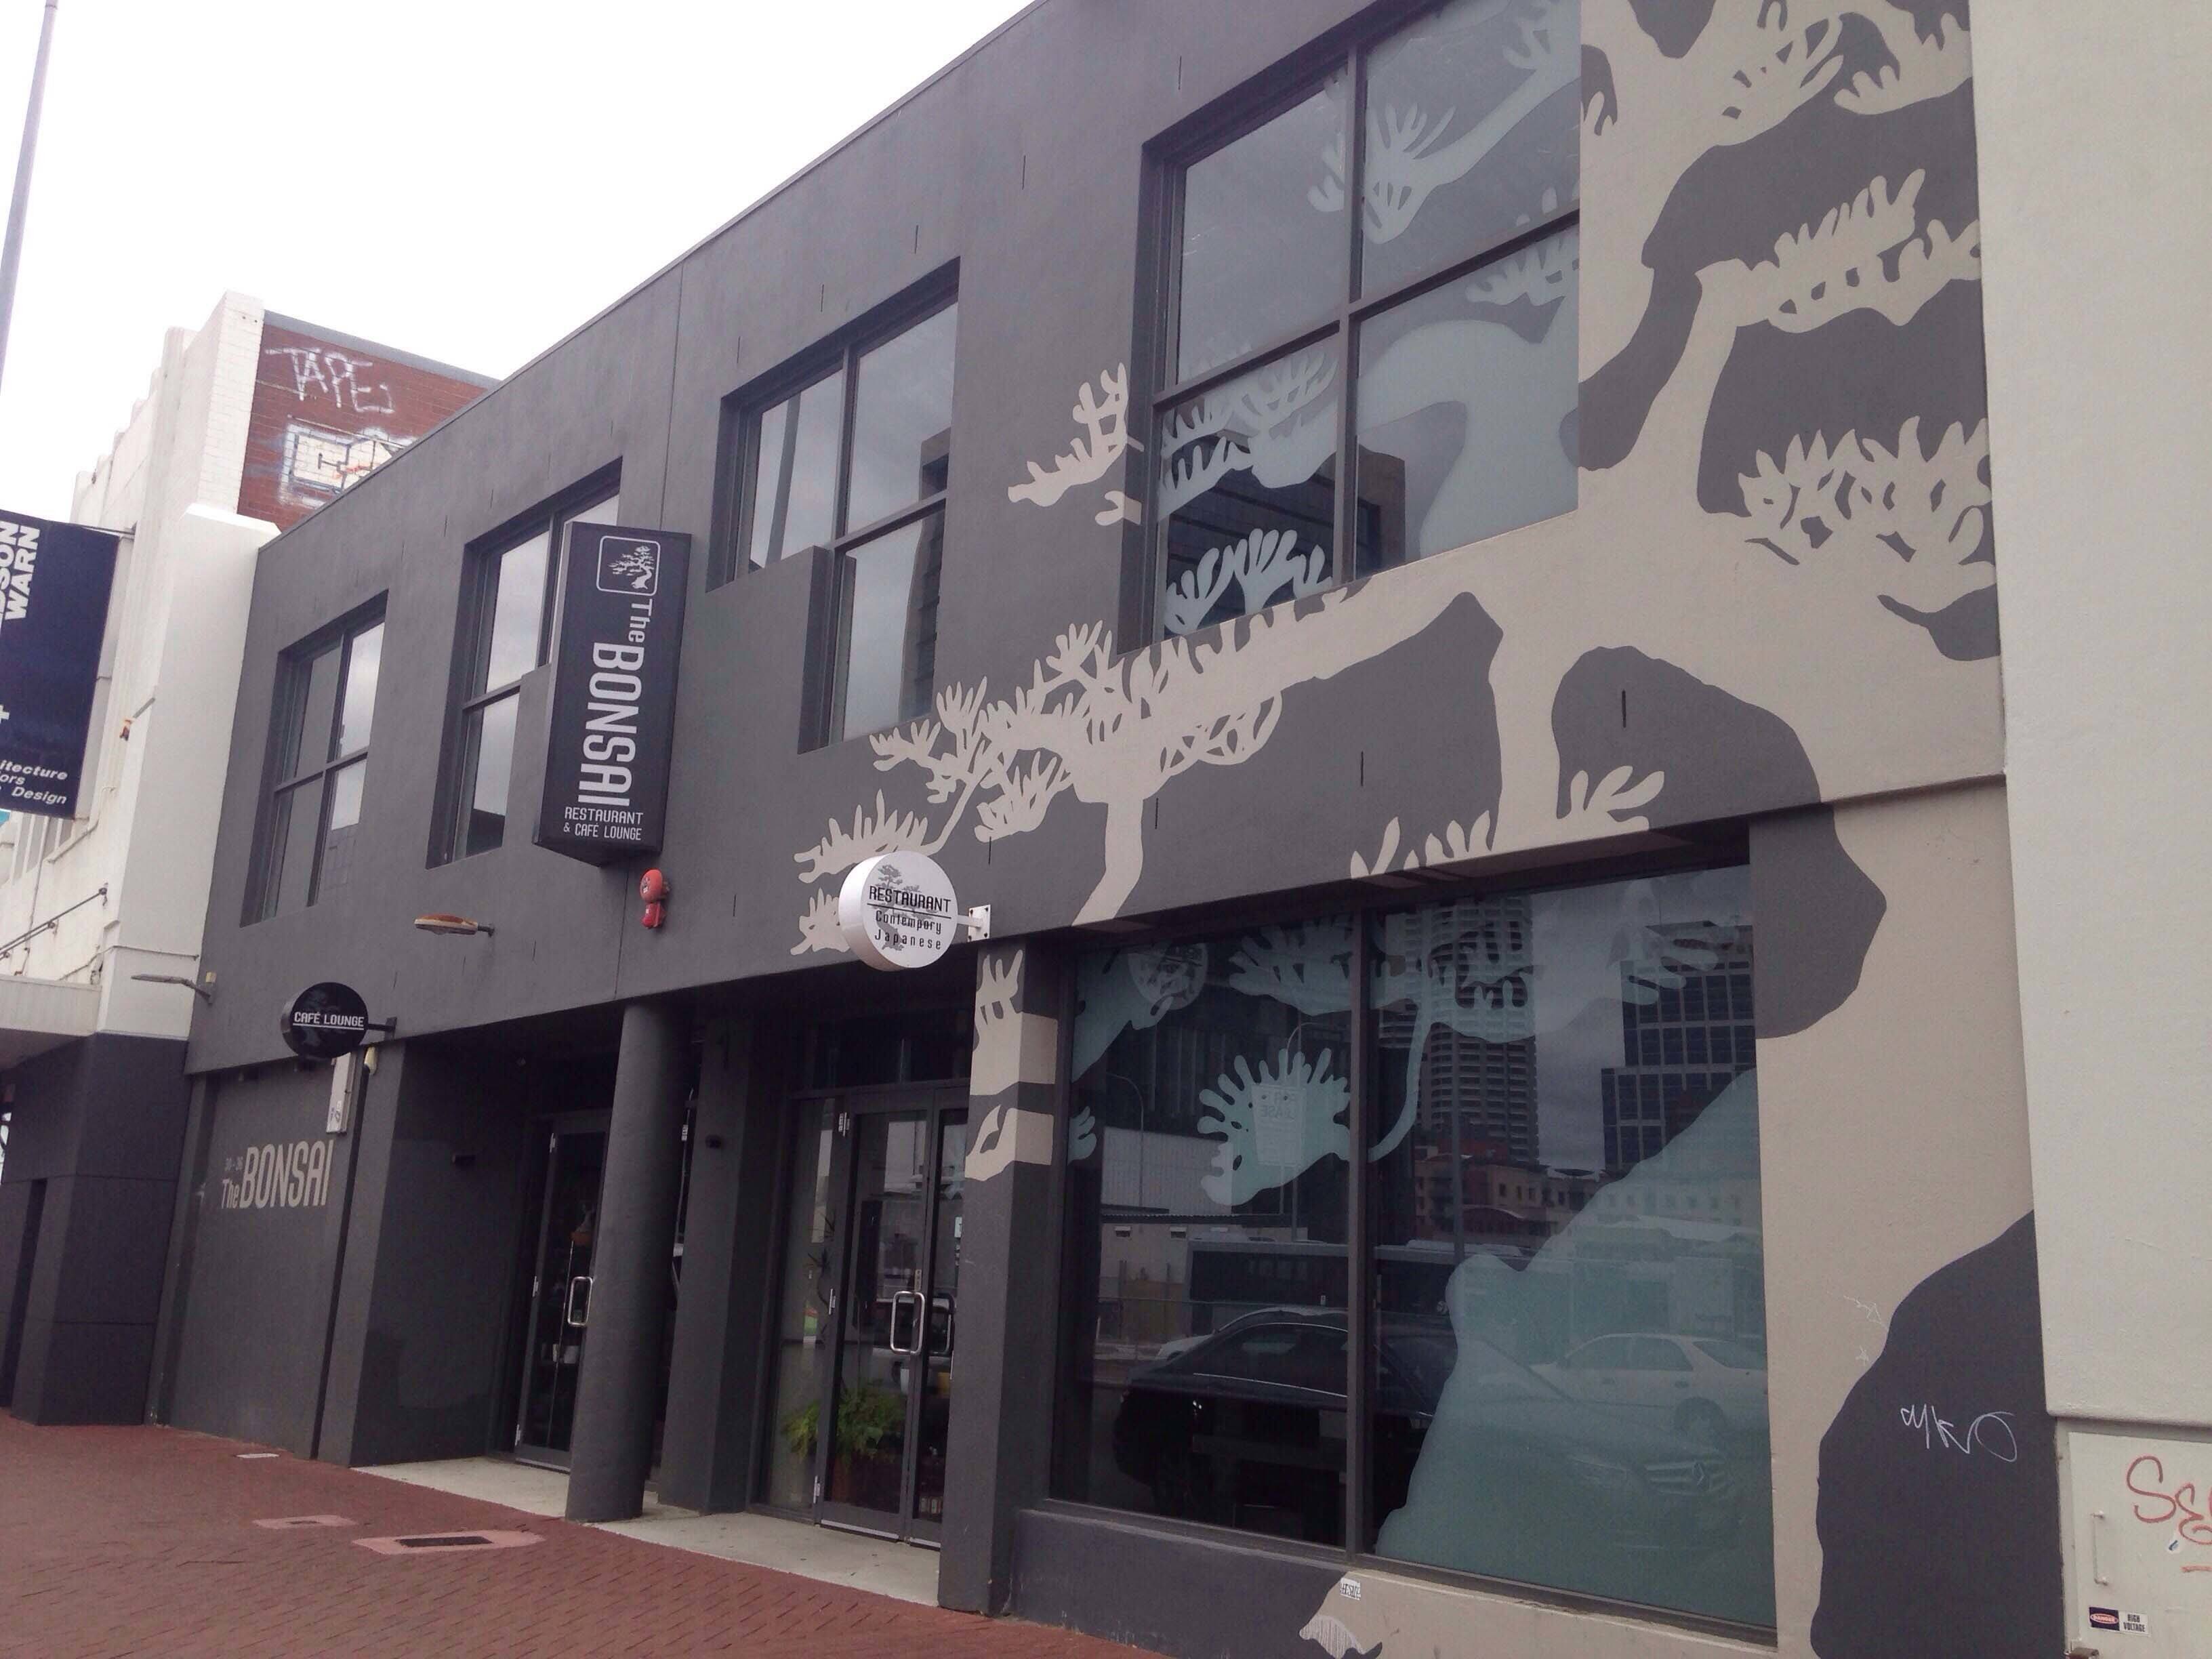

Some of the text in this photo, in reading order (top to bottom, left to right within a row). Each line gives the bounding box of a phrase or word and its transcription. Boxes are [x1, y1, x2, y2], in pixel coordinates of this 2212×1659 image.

[0, 520, 19, 632] SON
[5, 525, 41, 619] WARN
[577, 598, 653, 806] The BONSAI
[0, 760, 68, 780] itecture
[12, 786, 68, 804] Design
[565, 806, 644, 825] RESTAURANT
[563, 822, 642, 840] & CAFÉ LOUNGE
[869, 885, 951, 913] RESTAURANT
[876, 909, 941, 935] Contempory
[874, 929, 941, 949] Japanese
[294, 1011, 365, 1027] CAFÉ LOUNGE
[221, 1139, 334, 1209] The BONSAI
[2123, 1622, 2146, 1632] VOLTAGE
